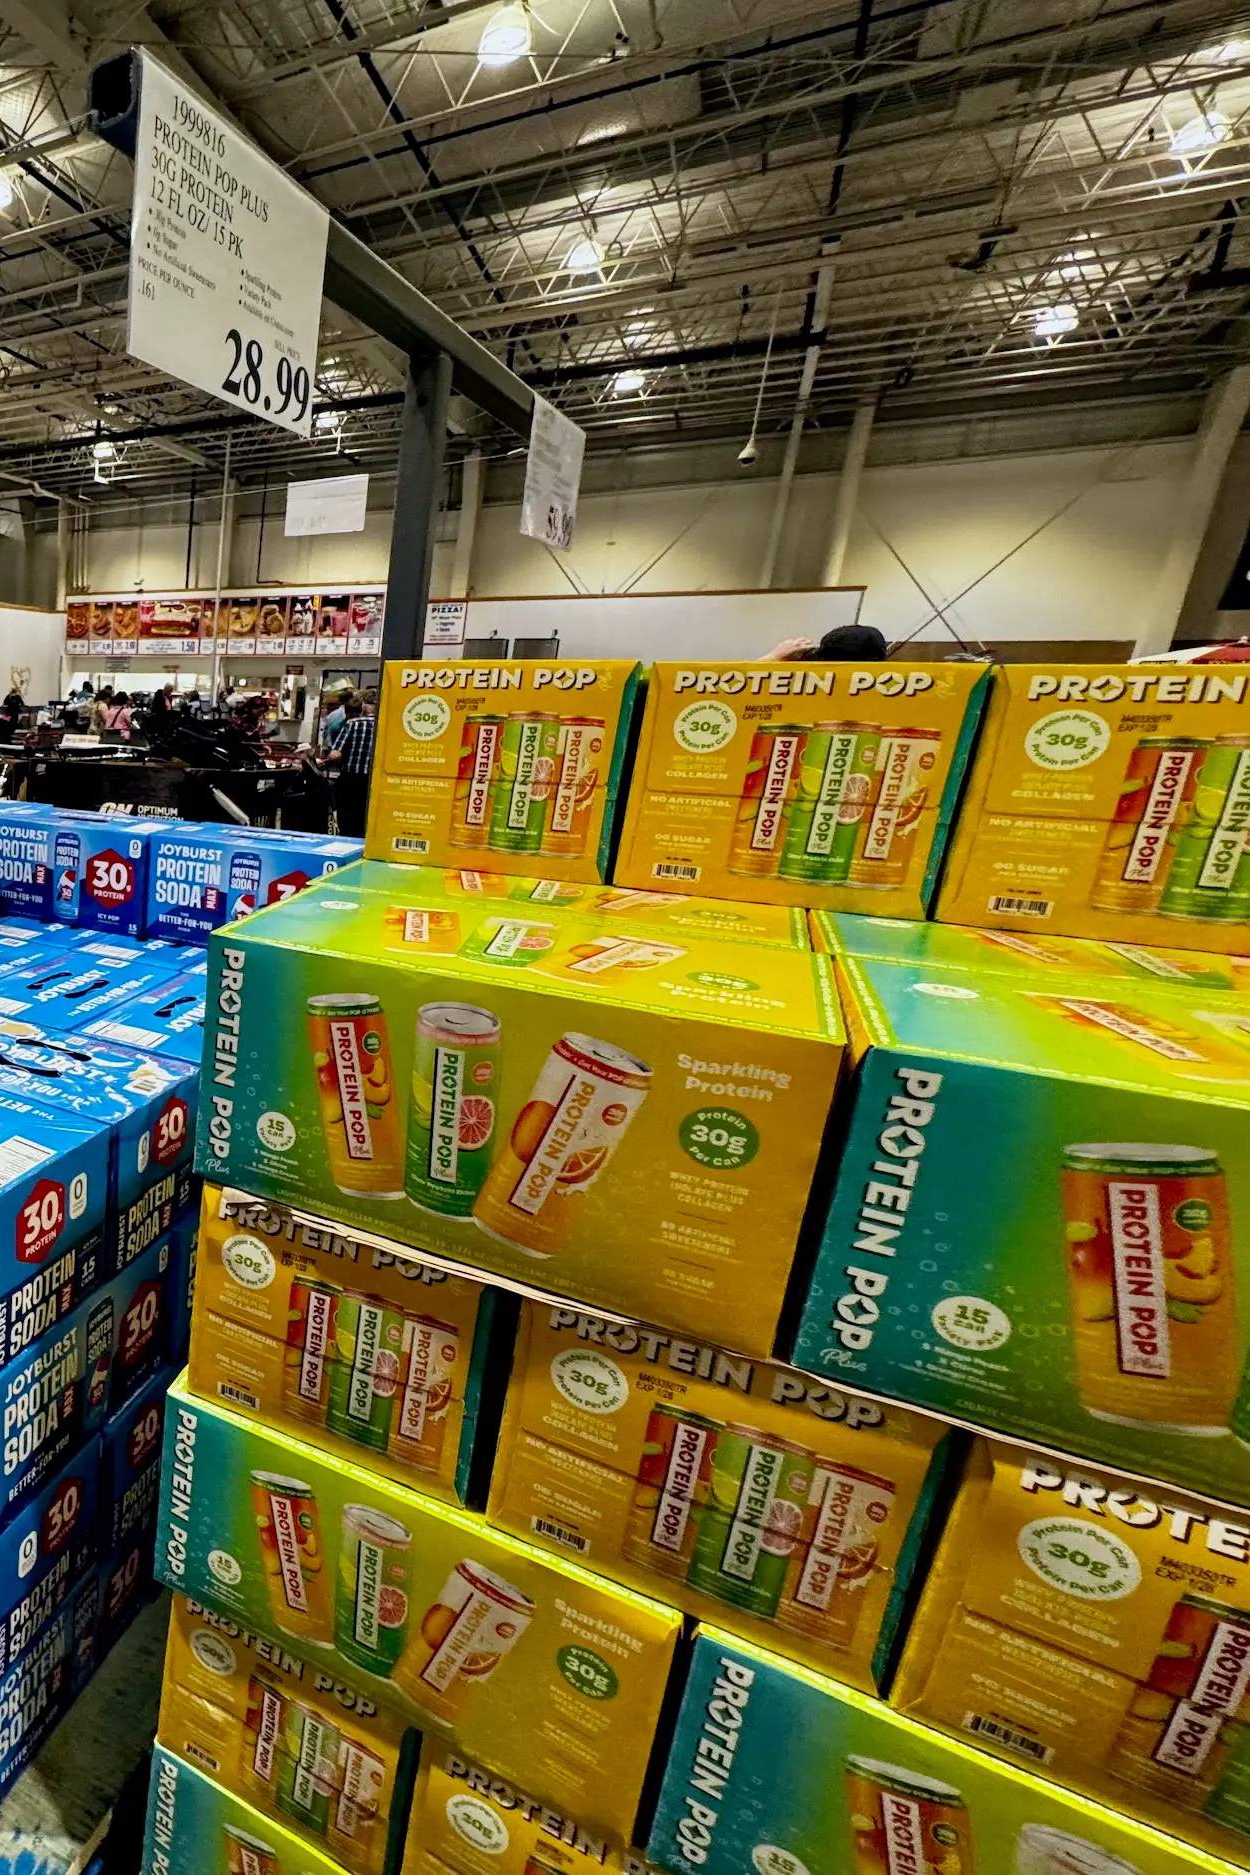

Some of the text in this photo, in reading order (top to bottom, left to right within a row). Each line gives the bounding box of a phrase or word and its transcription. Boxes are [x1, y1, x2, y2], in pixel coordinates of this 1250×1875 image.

[173, 95, 226, 158] 1999816
[154, 116, 269, 223] PROTEIN POP PLUS
[151, 146, 234, 224] 30G PROTEIN
[151, 176, 244, 259] 12 FL OZ/ 15 PK
[138, 255, 195, 299] PRICE PER OUNCE
[138, 278, 155, 301] .161
[222, 329, 310, 422] 28.99
[431, 606, 463, 614] PIZZA!
[401, 668, 597, 690] PROTEIN POP
[674, 671, 934, 697] PROTEIN POP
[1028, 675, 1250, 704] PROTEIN
[414, 711, 439, 725] 30g
[681, 703, 731, 724] Protein Per Can
[689, 721, 722, 735] 30g
[678, 730, 700, 750] Protein
[715, 731, 730, 745] Can
[1046, 733, 1089, 750] 30g
[665, 770, 729, 780] COLLAGEN
[760, 739, 793, 839] PROTEIN POP
[815, 737, 851, 841] PROTEIN POP
[137, 805, 179, 817] OPTIMUM
[650, 795, 732, 808] NO ARTIFICIAL
[158, 844, 223, 861] JOYBURST
[672, 834, 712, 844] SUGAR
[156, 859, 222, 887] PROTEIN
[158, 914, 213, 931] BETTER-FOR-YOU
[204, 948, 246, 1177] PROTEIN POP Plus
[677, 1053, 792, 1090] Sparkling
[337, 1027, 369, 1146] PROTEIN POP
[685, 1076, 774, 1102] Protein
[267, 1118, 285, 1132] 15
[437, 1053, 459, 1170] PROTEIN POP
[697, 1111, 748, 1131] Protein
[268, 1129, 284, 1139] can
[690, 1124, 748, 1156] 30g
[689, 1145, 741, 1167] Per Can
[23, 1192, 63, 1248] 30g
[819, 1068, 945, 1372] PROTEIN POP Plus
[25, 1230, 58, 1260] PROTEIN
[218, 1194, 359, 1262] PROTEIN
[372, 1242, 448, 1287] POP
[11, 1250, 76, 1323] PROTEIN
[10, 1300, 57, 1356] SODA
[954, 1304, 991, 1325] 15
[550, 1307, 885, 1429] PROTEIN POP
[570, 1369, 610, 1397] 30g
[164, 1407, 199, 1577] PROTEIN POP
[1046, 1542, 1112, 1579] 30g
[675, 1657, 756, 1864] PROTEIN POP
